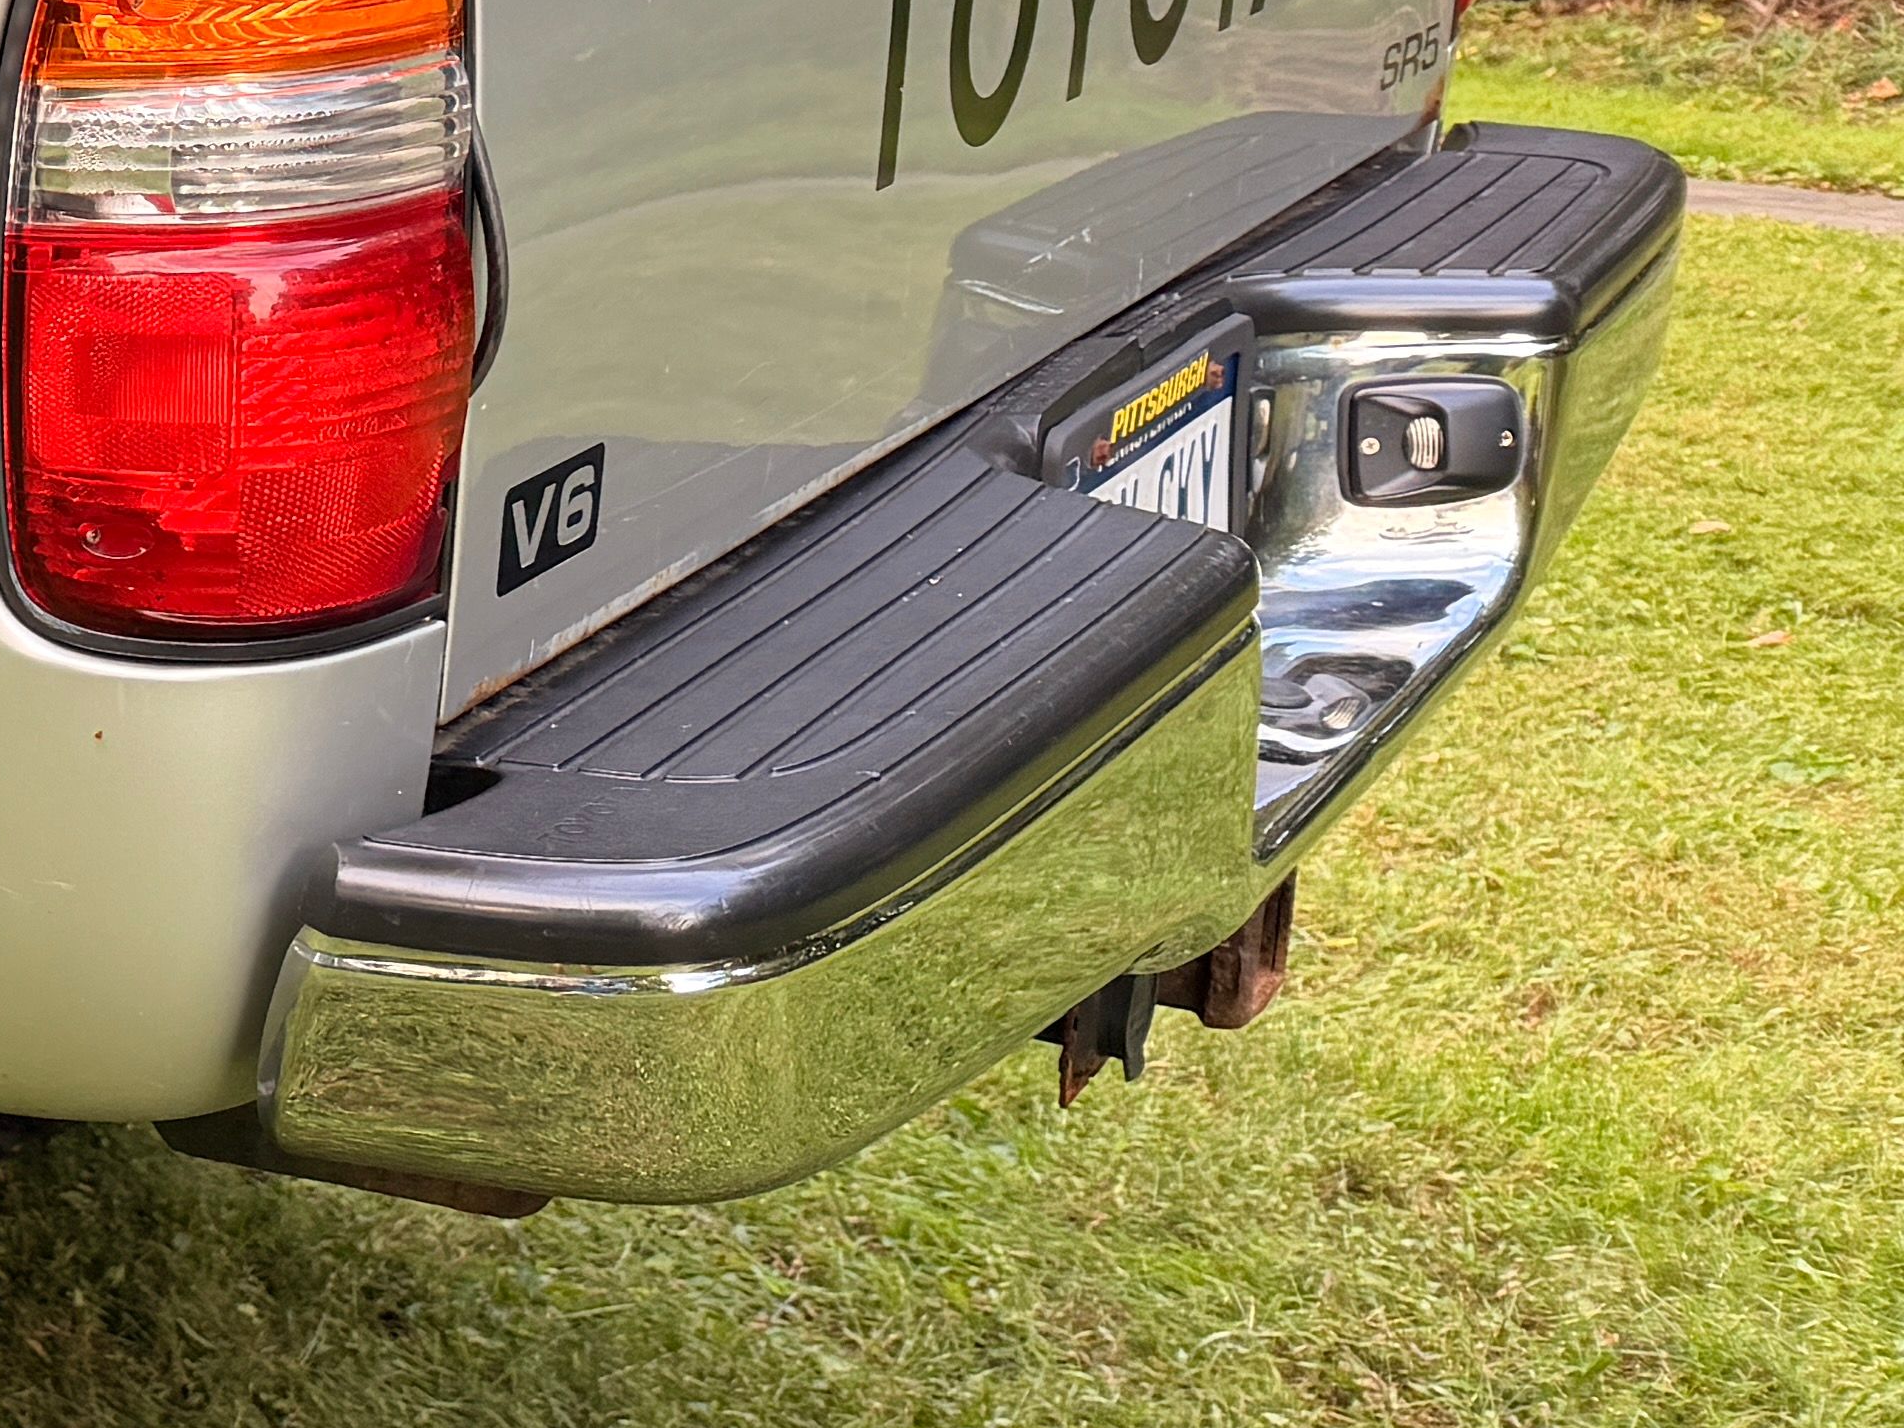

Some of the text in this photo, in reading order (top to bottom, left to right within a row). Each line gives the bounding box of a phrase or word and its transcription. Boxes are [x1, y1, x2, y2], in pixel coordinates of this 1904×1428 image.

[1380, 22, 1440, 91] SR5
[1111, 348, 1210, 444] PITTSBURGH
[511, 465, 595, 569] V6
